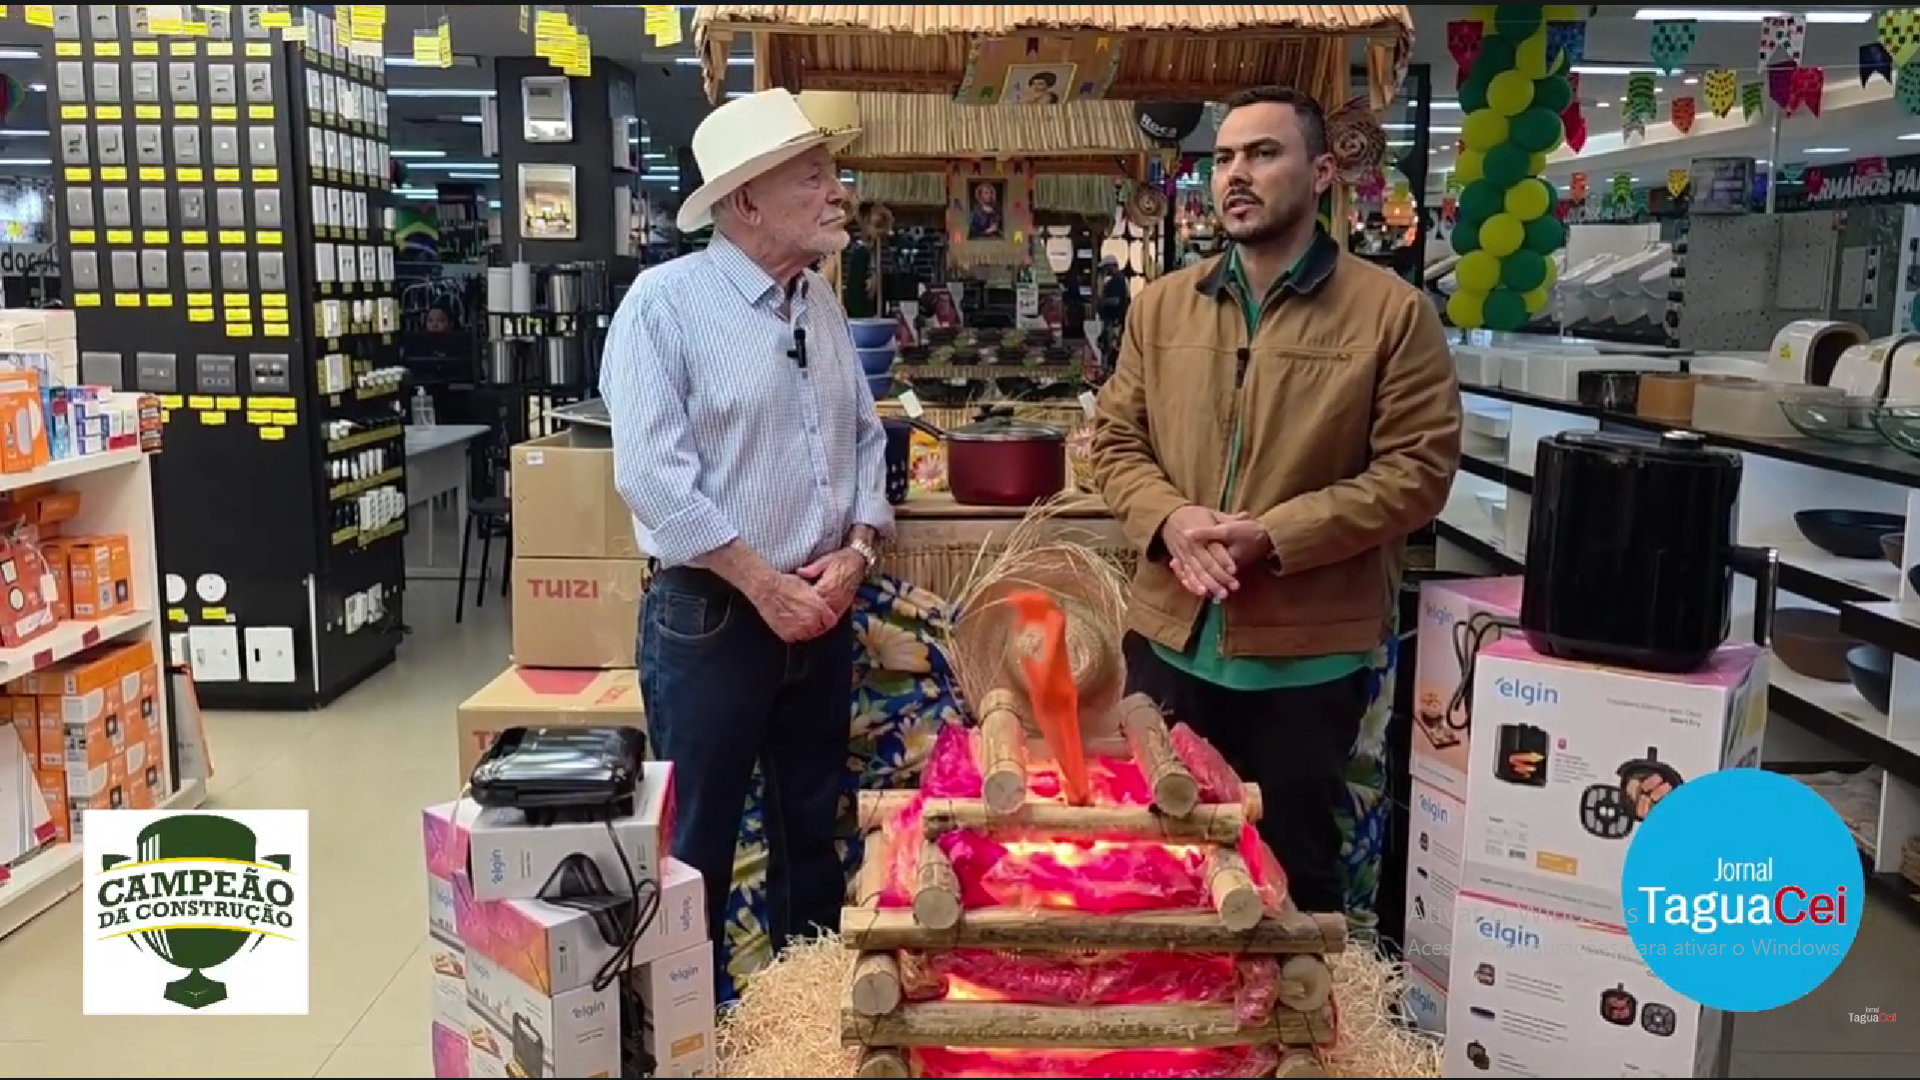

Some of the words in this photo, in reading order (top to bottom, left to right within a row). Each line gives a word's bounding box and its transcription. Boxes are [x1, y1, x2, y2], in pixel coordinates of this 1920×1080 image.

[1892, 165, 1919, 194] PA
[527, 579, 598, 598] TUIZI
[1494, 678, 1559, 706] elgin
[1419, 795, 1448, 823] elgin
[490, 848, 506, 885] elgin
[1477, 916, 1540, 948] elgin
[669, 966, 699, 981] elgin
[572, 1001, 605, 1018] elgin
